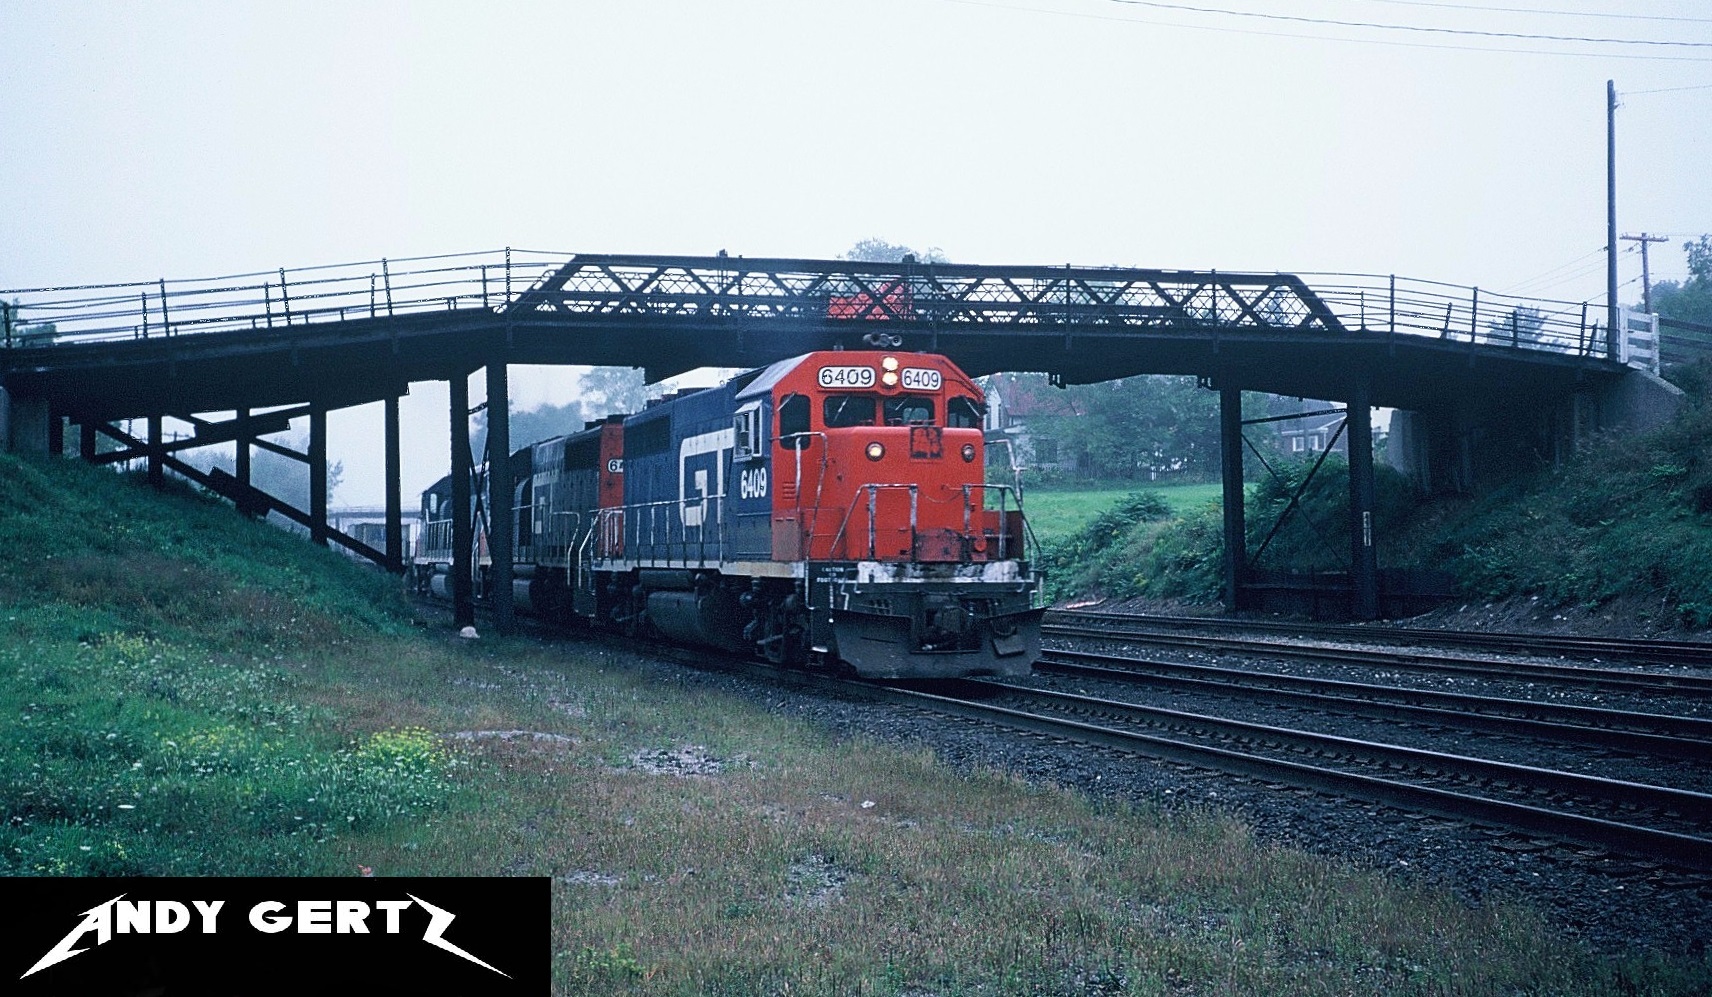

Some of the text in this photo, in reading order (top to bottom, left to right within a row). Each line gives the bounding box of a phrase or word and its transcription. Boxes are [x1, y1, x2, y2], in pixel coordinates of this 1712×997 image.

[821, 368, 873, 386] 6409
[903, 369, 940, 388] 6409
[741, 467, 767, 499] 6409
